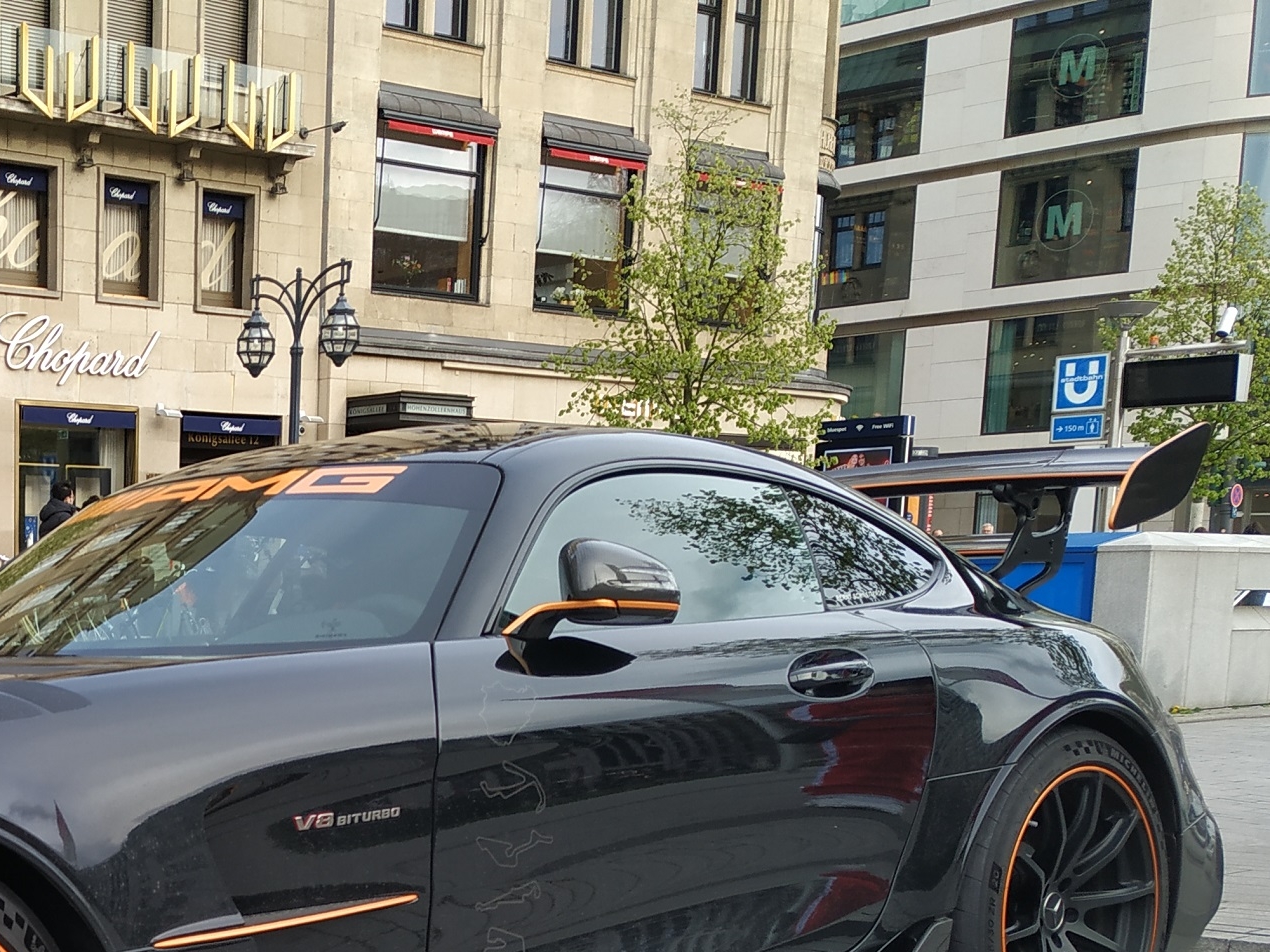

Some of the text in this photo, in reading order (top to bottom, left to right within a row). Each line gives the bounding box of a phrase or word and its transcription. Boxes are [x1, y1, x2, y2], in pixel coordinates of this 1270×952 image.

[5, 171, 34, 187] Chopard
[109, 186, 138, 201] Chopard
[207, 200, 233, 216] Chopard
[1045, 201, 1083, 240] M
[1060, 374, 1104, 384] stadtbahn
[1063, 359, 1100, 405] U
[406, 404, 467, 415] HOHENZOLLERNHAUS
[66, 412, 96, 425] Chopard
[220, 420, 246, 434] Chopard
[249, 435, 260, 445] 12
[293, 807, 401, 832] V8 BITURBO
